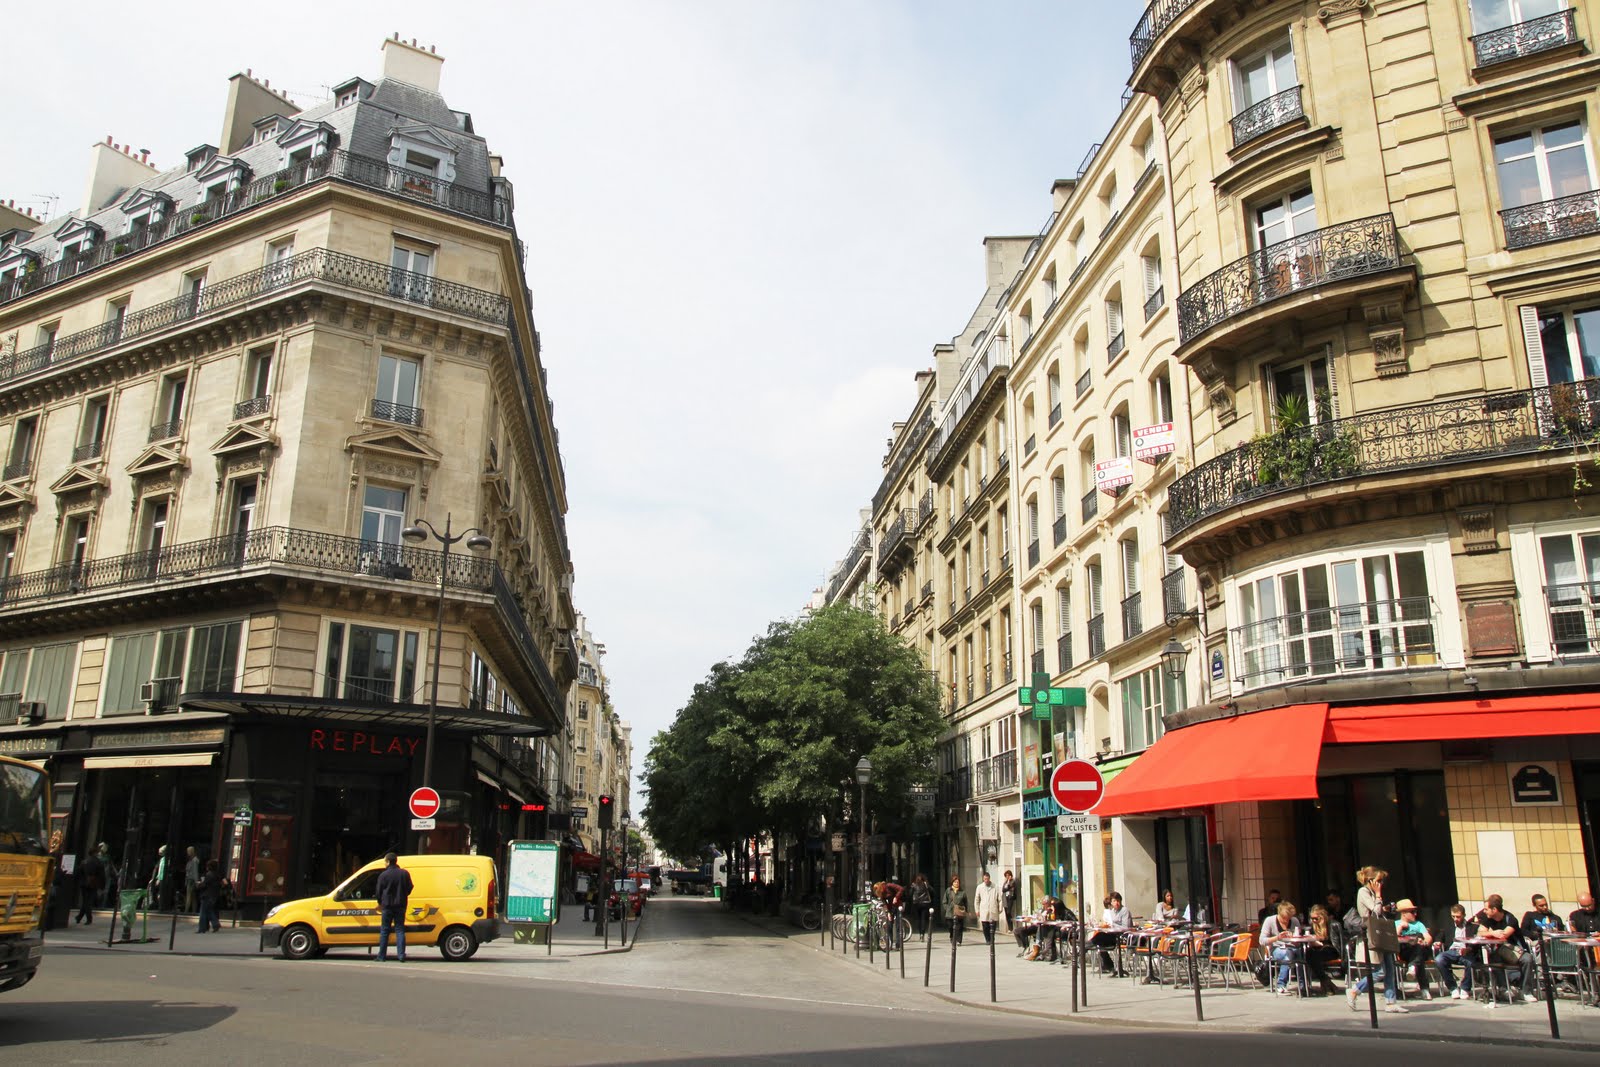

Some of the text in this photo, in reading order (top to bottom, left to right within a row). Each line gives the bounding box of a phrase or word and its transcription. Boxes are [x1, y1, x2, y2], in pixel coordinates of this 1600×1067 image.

[1137, 425, 1168, 436] VENDU
[311, 729, 419, 755] REPLAY
[1060, 824, 1098, 832] CYCLISTES
